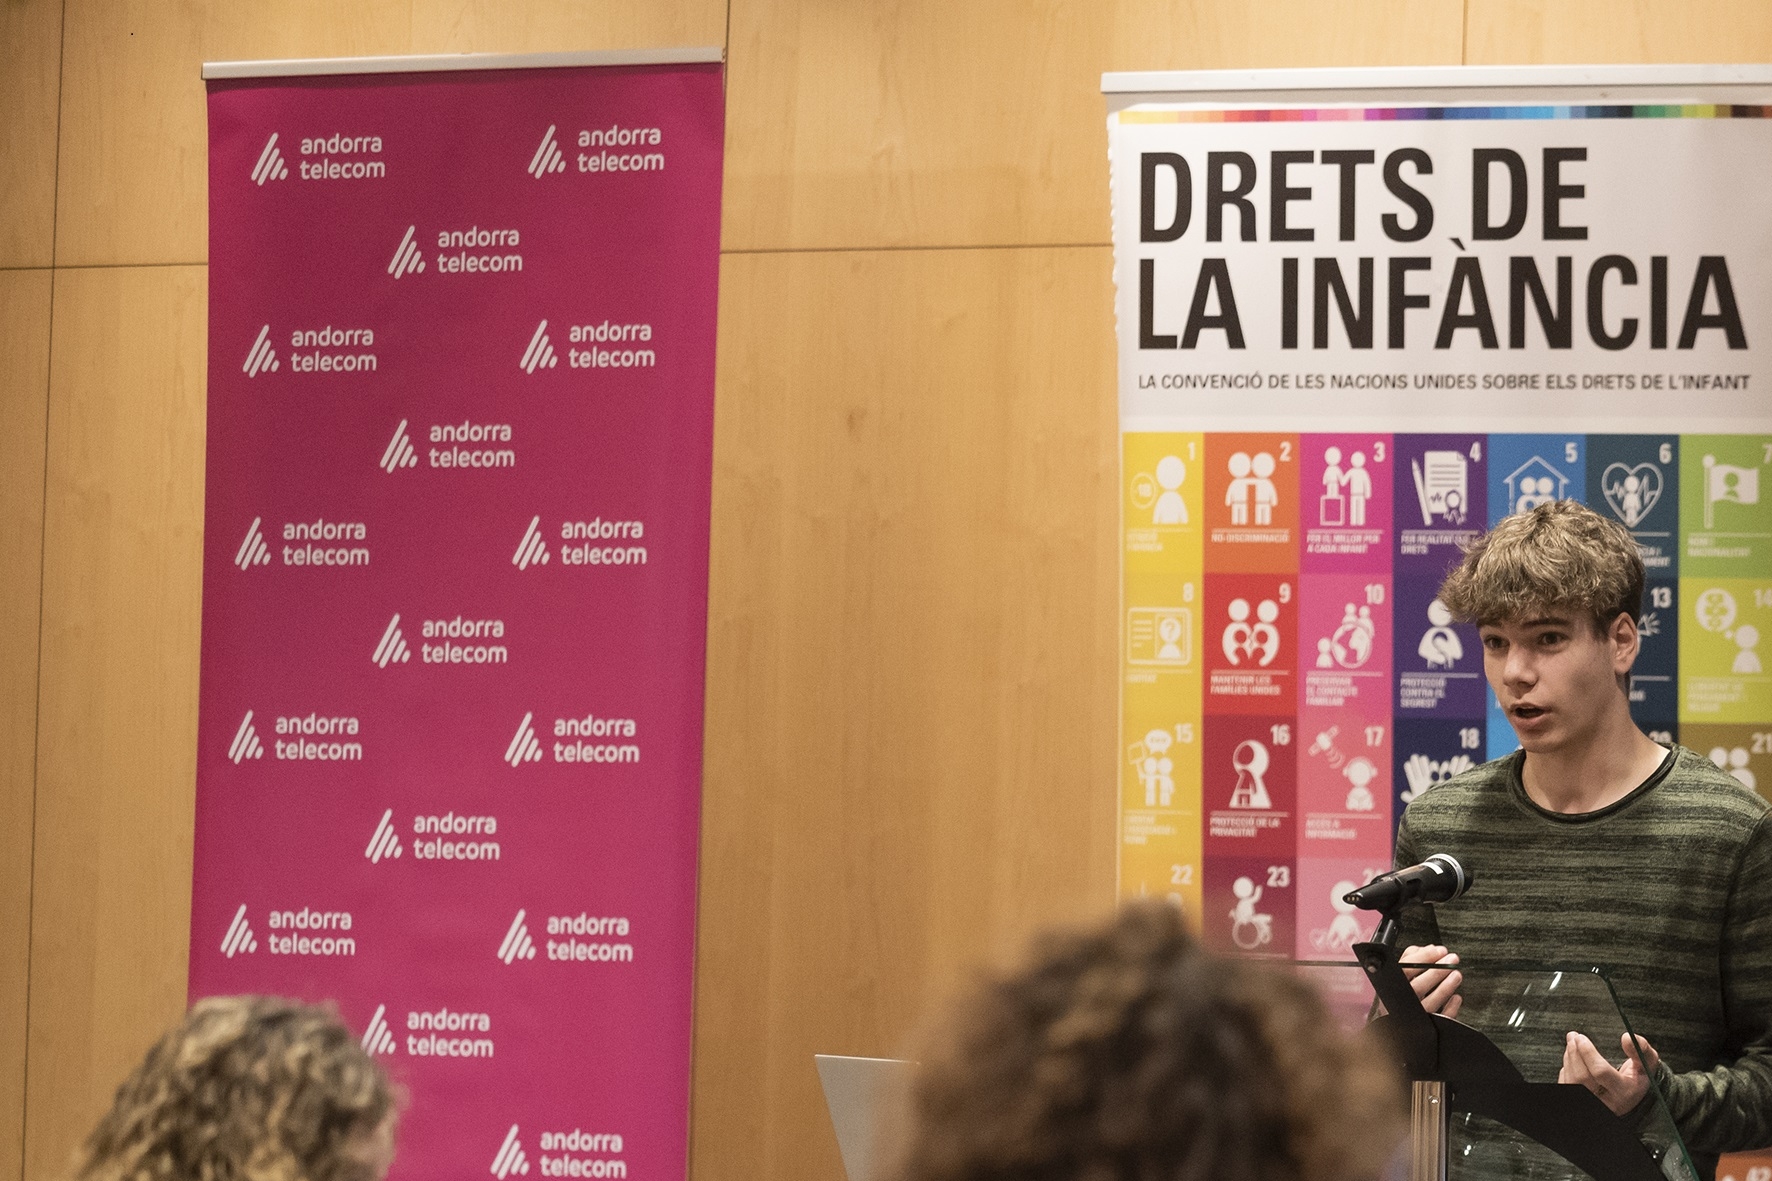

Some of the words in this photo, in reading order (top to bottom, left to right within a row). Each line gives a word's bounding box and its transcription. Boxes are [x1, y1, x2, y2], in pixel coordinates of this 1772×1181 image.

[301, 133, 382, 154] andorra
[579, 125, 661, 146] andorra
[300, 159, 385, 179] telecom
[578, 151, 664, 172] telecom
[1140, 148, 1434, 242] DRETS
[1473, 148, 1588, 240] DE
[438, 226, 519, 247] andorra
[438, 252, 522, 272] telecom
[1139, 258, 1246, 349] LA
[1281, 237, 1749, 351] INFÀNCIA
[292, 326, 373, 346] andorra
[570, 321, 651, 342] andorra
[291, 351, 376, 371] telecom
[569, 347, 655, 367] telecom
[1139, 374, 1156, 389] LA
[1161, 371, 1262, 389] CONVENCIÓ
[1268, 374, 1289, 389] DE
[1295, 374, 1324, 389] LES
[1331, 374, 1408, 389] NACIONS
[1414, 374, 1476, 389] UNIDES
[1482, 374, 1539, 389] SOBRE
[1546, 374, 1577, 389] ELS
[1582, 374, 1635, 389] DRETS
[1641, 374, 1663, 389] DE
[1669, 374, 1750, 389] L'INFANT
[430, 421, 511, 442] andorra
[429, 447, 514, 467] telecom
[1187, 441, 1196, 461] 1
[1279, 441, 1292, 462] 2
[1373, 441, 1386, 463] 3
[1469, 441, 1482, 463] 4
[1565, 441, 1578, 463] 5
[1658, 442, 1672, 464] 6
[283, 519, 366, 539] andorra
[562, 518, 643, 538] andorra
[283, 544, 369, 565] telecom
[561, 544, 647, 564] telecom
[1278, 582, 1291, 604] 9
[1364, 583, 1385, 605] 10
[1651, 586, 1672, 609] 13
[423, 616, 504, 637] andorra
[422, 642, 507, 663] telecom
[276, 713, 358, 734] andorra
[554, 715, 635, 736] andorra
[1175, 723, 1193, 744] 15
[1270, 724, 1291, 746] 16
[1364, 725, 1385, 747] 17
[1459, 727, 1480, 749] 18
[276, 739, 362, 760] telecom
[554, 741, 639, 762] telecom
[414, 812, 496, 834] andorra
[414, 838, 500, 859] telecom
[1171, 863, 1193, 885] 22
[1267, 865, 1291, 888] 23
[269, 908, 351, 930] andorra
[547, 912, 629, 936] andorra
[269, 933, 355, 955] telecom
[547, 939, 633, 961] telecom
[408, 1008, 490, 1031] andorra
[407, 1034, 493, 1056] telecom
[541, 1129, 622, 1153] andorra
[540, 1155, 626, 1177] telecom
